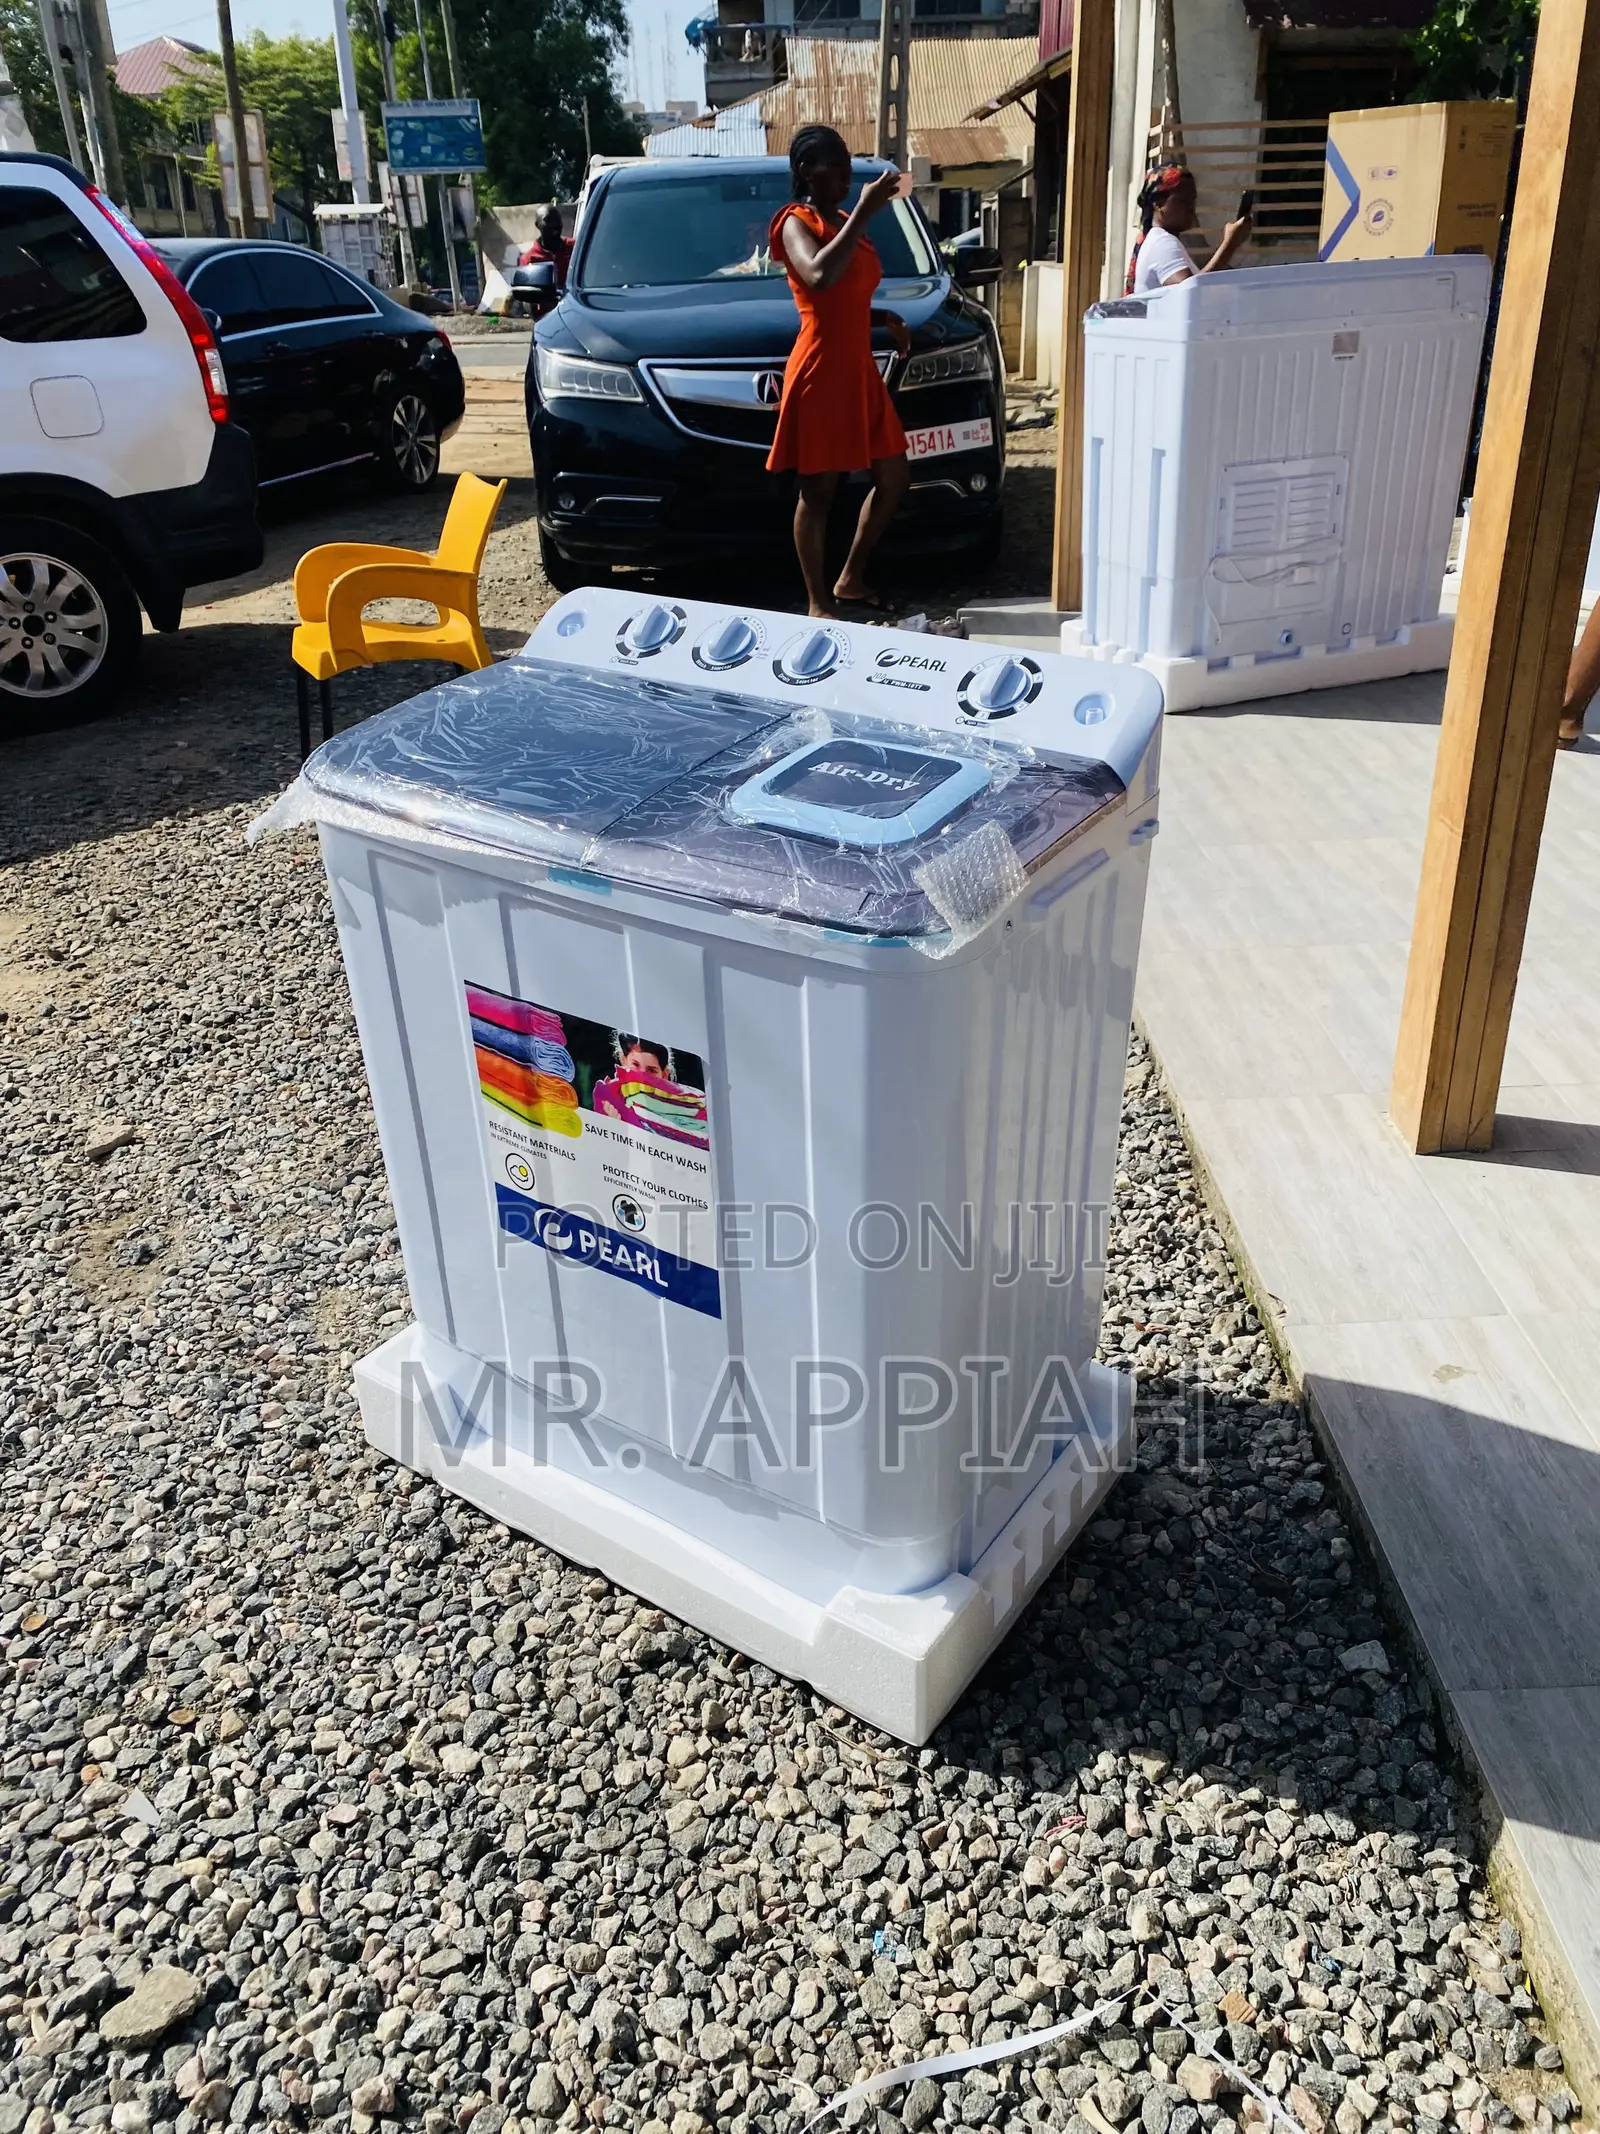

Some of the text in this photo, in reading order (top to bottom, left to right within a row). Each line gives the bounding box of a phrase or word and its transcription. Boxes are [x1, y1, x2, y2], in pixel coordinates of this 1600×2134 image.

[898, 655, 947, 672] PEARL
[808, 761, 920, 791] Air-Dry
[489, 1120, 576, 1161] RESISTANT MATERIALS
[497, 1134, 520, 1149] EXTREME
[520, 1145, 547, 1159] CLIMATES
[585, 1123, 707, 1174] SAVE TIME IN EACH WASH
[602, 1164, 709, 1210] PROTECT YOUR CLOTHES
[603, 1175, 656, 1201] EFFICIENTLY WASH
[579, 1228, 669, 1288] PEARL
